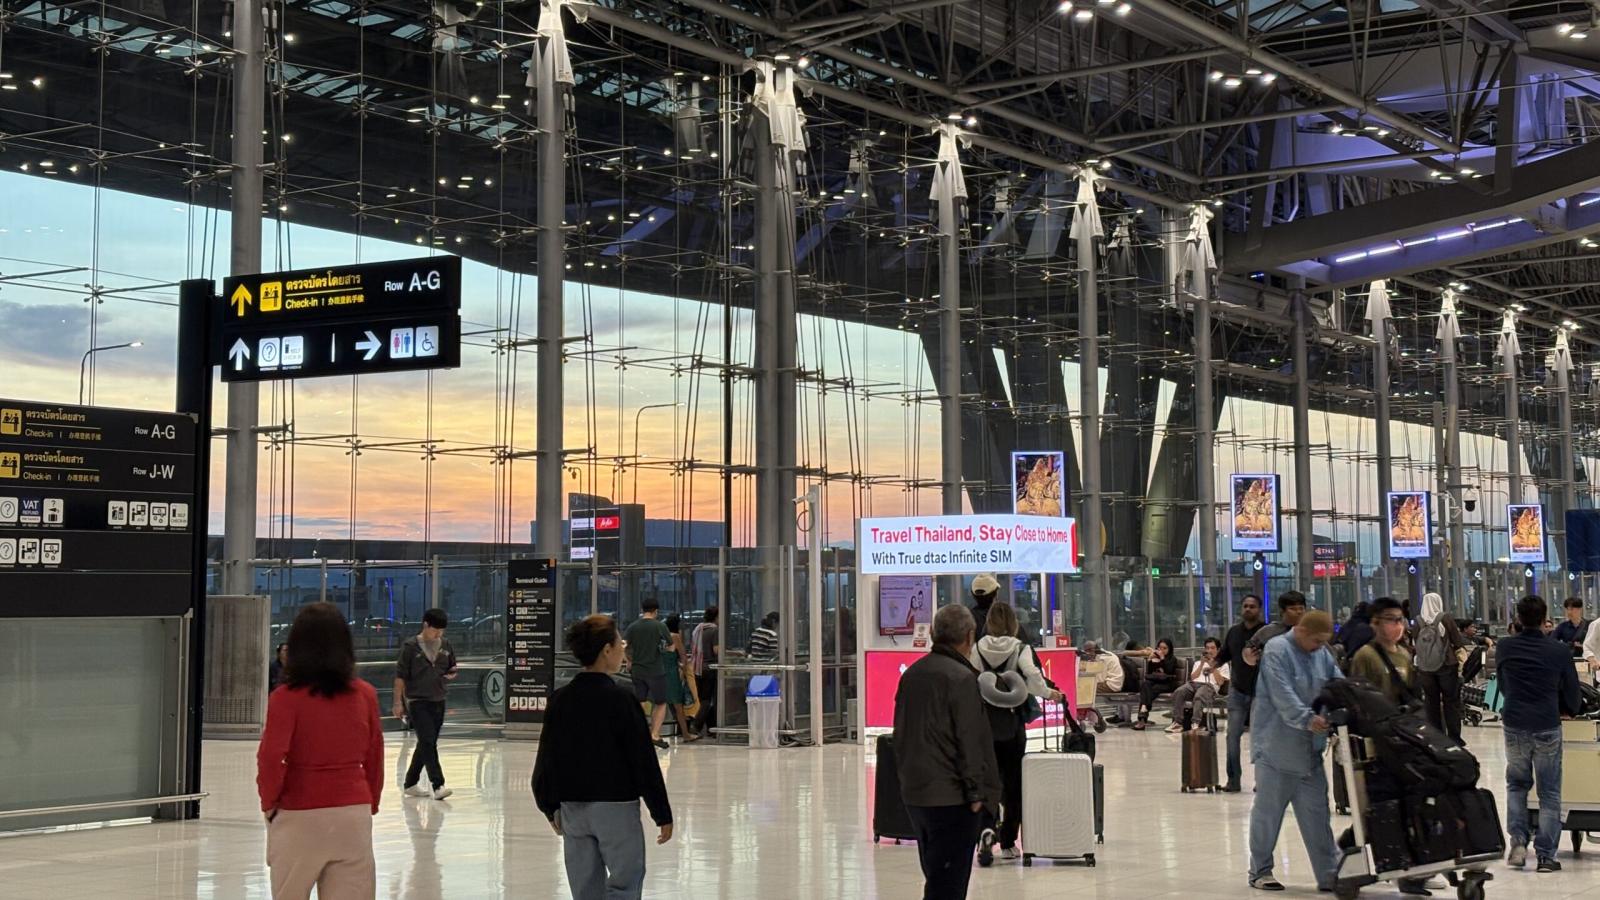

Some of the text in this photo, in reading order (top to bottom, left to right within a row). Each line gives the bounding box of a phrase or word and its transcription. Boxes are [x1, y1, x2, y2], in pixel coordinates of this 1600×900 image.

[286, 270, 361, 290] ตรวจบัตรโดยสาร
[384, 270, 441, 292] Row A-G
[285, 297, 319, 309] Check-in
[25, 408, 86, 422] ตรวจบัตรโดยสาร
[25, 428, 54, 439] Check-in
[135, 424, 176, 439] Row A-G
[23, 450, 84, 464] ตรวจบัตรโดยสาร
[23, 471, 52, 481] Check-in
[132, 463, 175, 479] Row J-W
[23, 500, 40, 510] VAT
[871, 525, 1068, 544] Travel Thailand, Stay Close to Home
[872, 549, 1012, 565] With True dtac Infinite SIM
